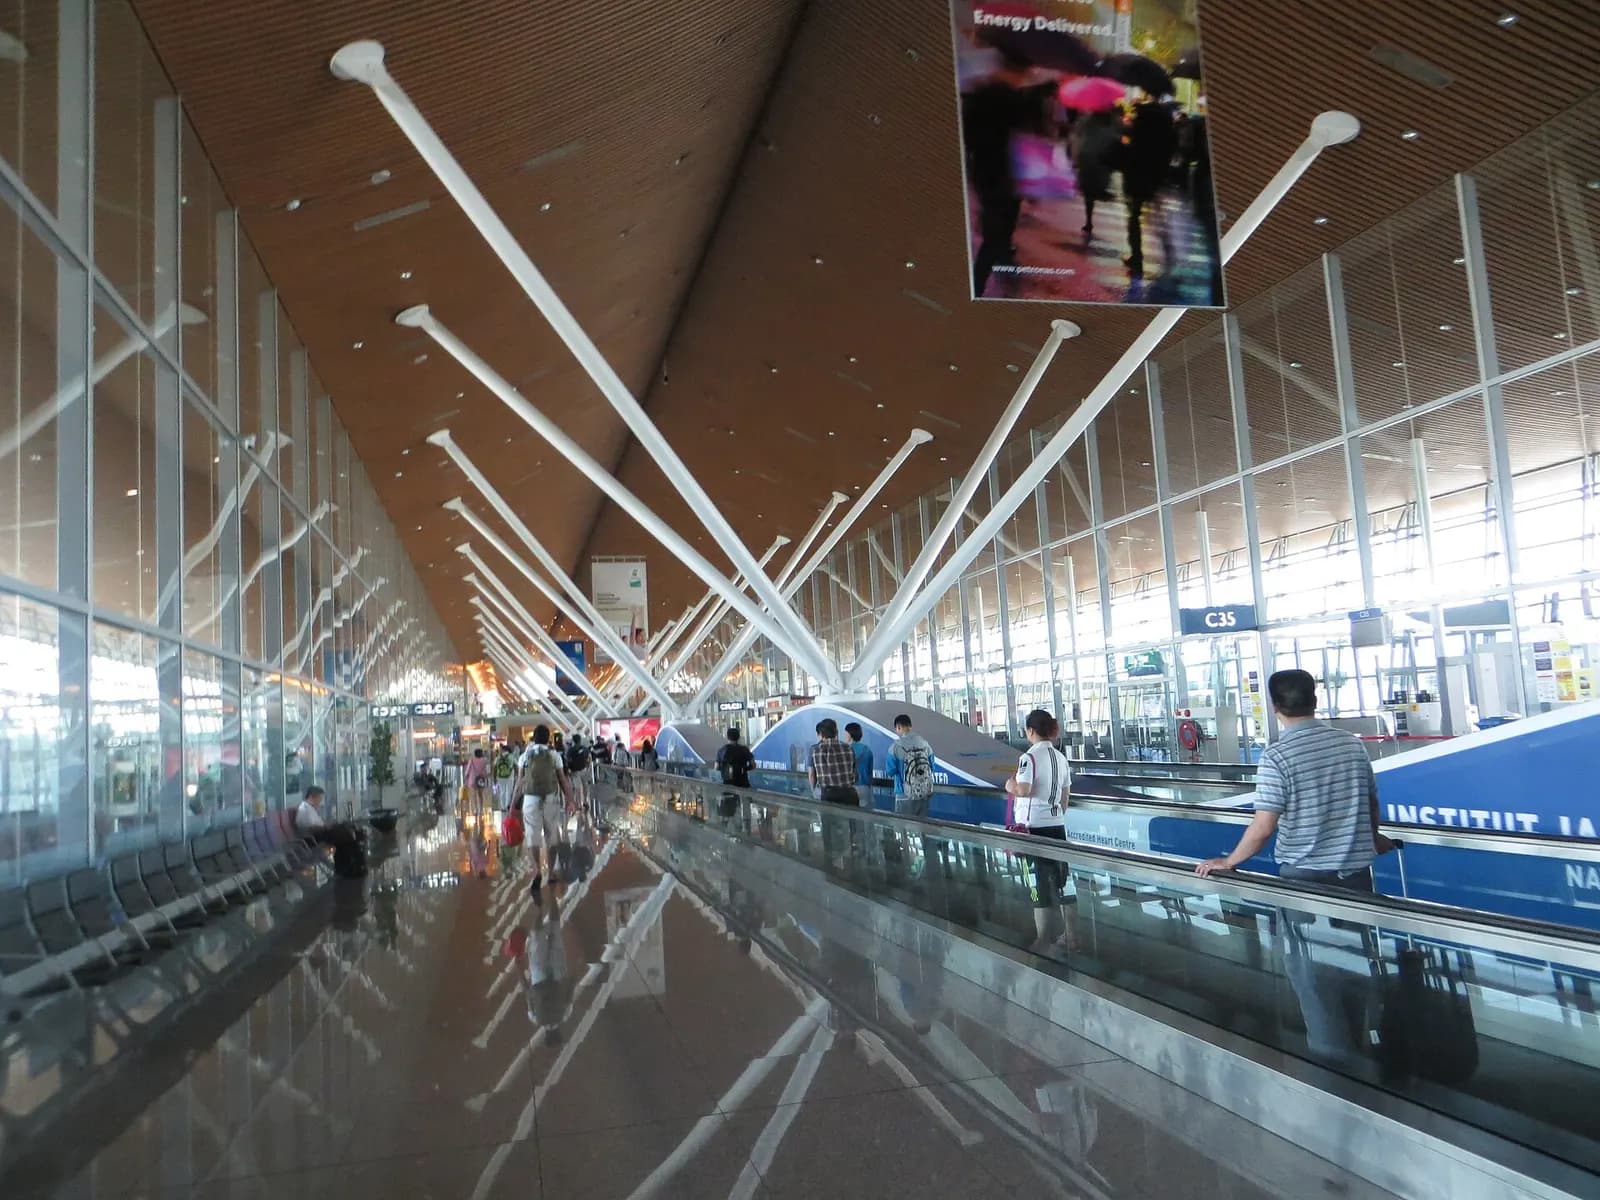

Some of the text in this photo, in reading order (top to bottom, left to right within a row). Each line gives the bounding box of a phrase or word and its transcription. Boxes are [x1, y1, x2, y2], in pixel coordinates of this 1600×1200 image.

[973, 10, 1116, 37] Energy Delivered.
[1205, 611, 1236, 628] C35
[1096, 834, 1113, 846] Heart
[1114, 837, 1136, 850] Centre
